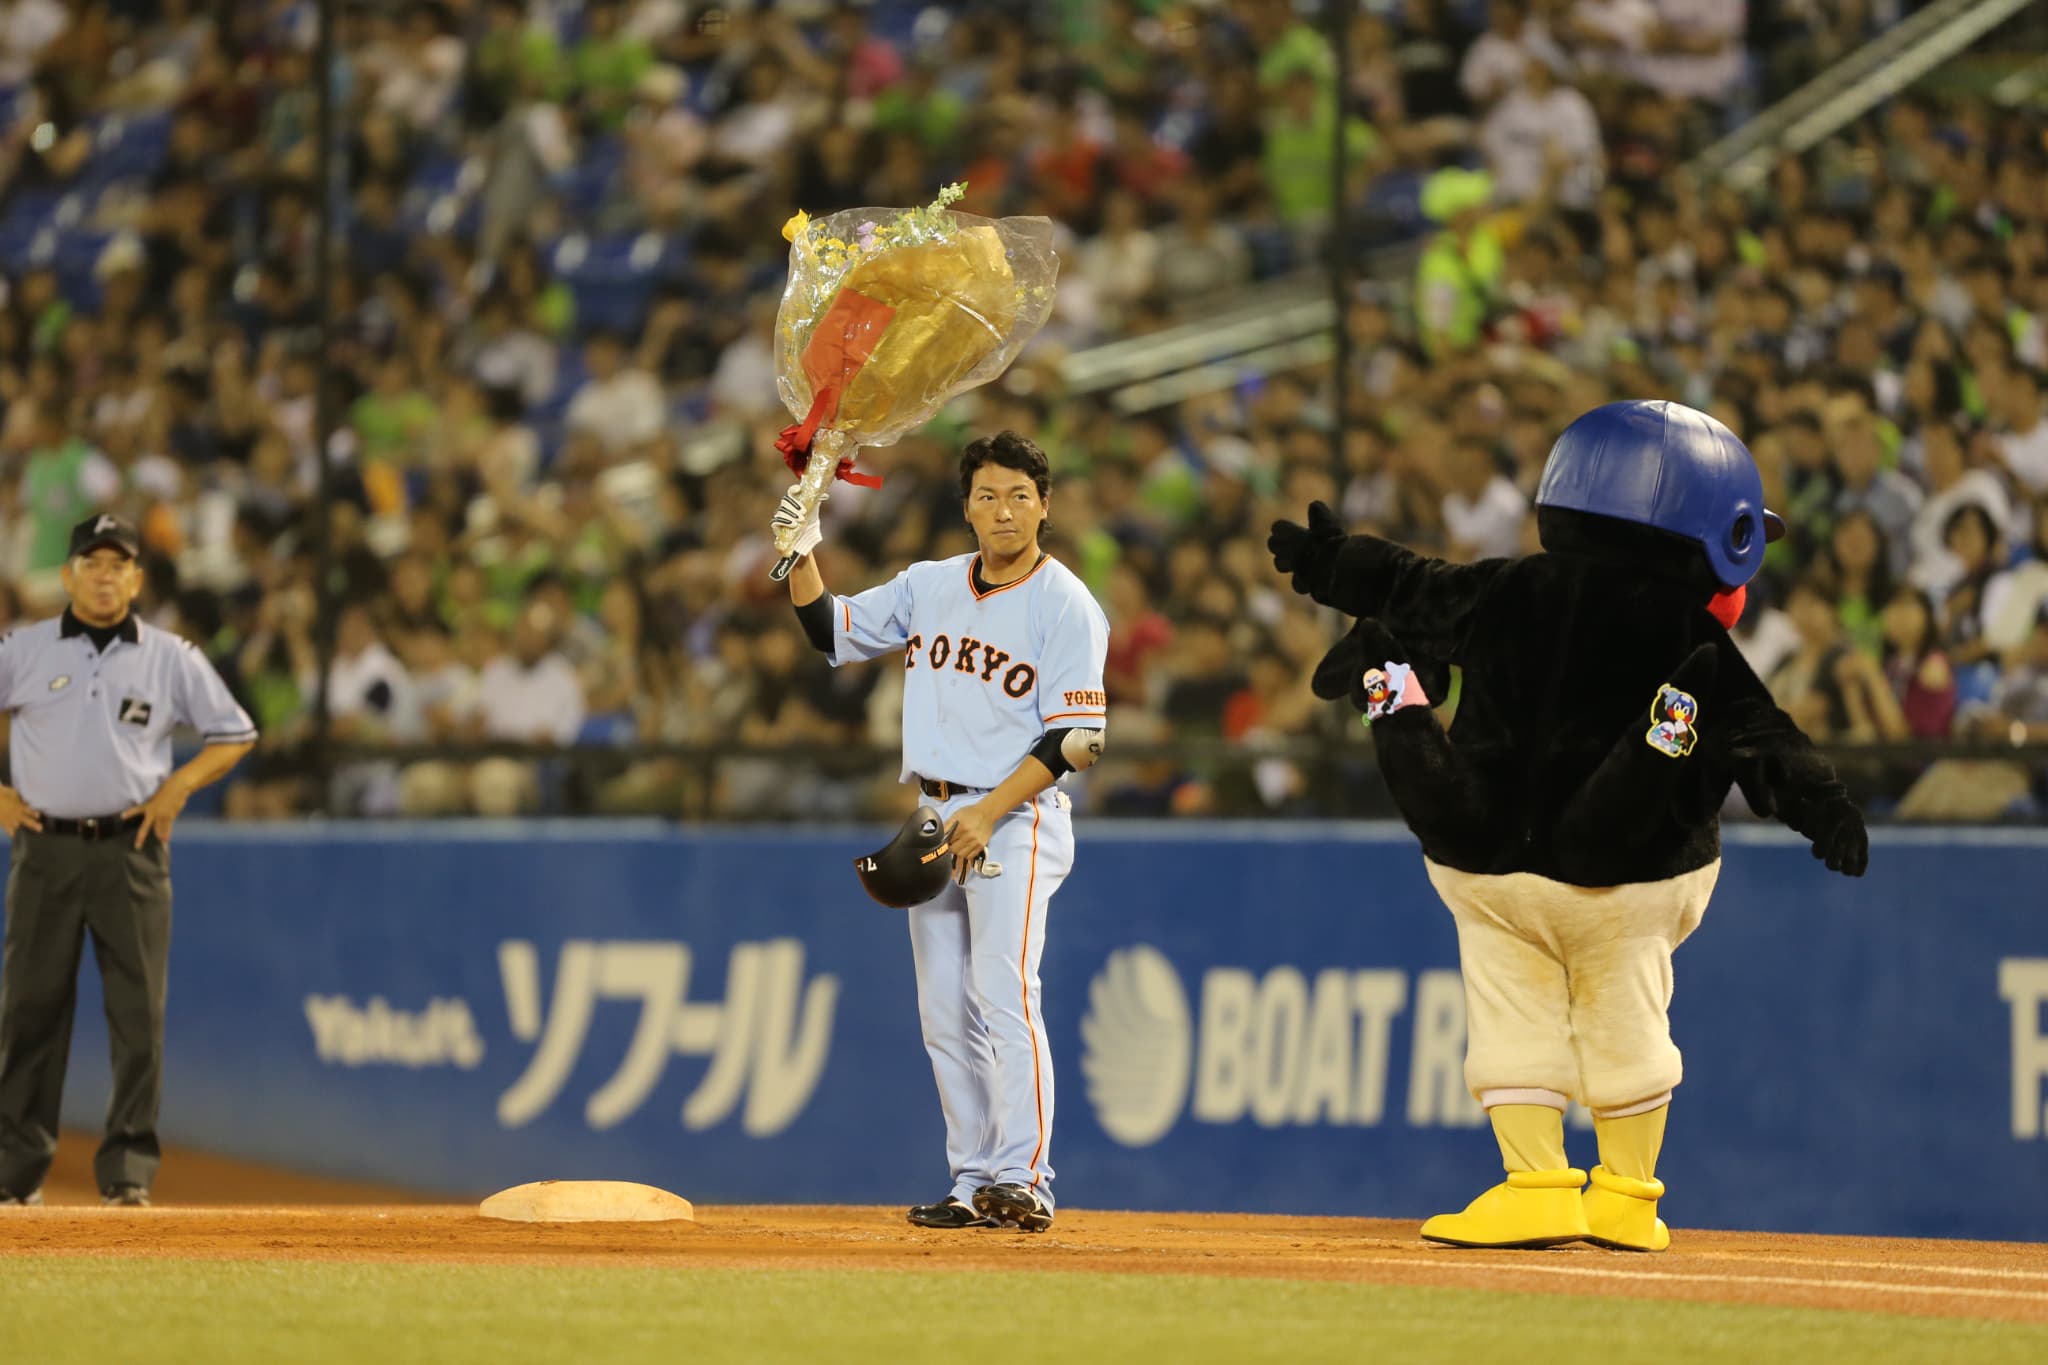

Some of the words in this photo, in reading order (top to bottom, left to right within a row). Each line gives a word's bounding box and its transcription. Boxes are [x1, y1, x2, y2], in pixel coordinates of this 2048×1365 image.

[906, 634, 1035, 698] TOKYO
[499, 939, 838, 1137] ソフール
[1194, 966, 1407, 1126] BOAT
